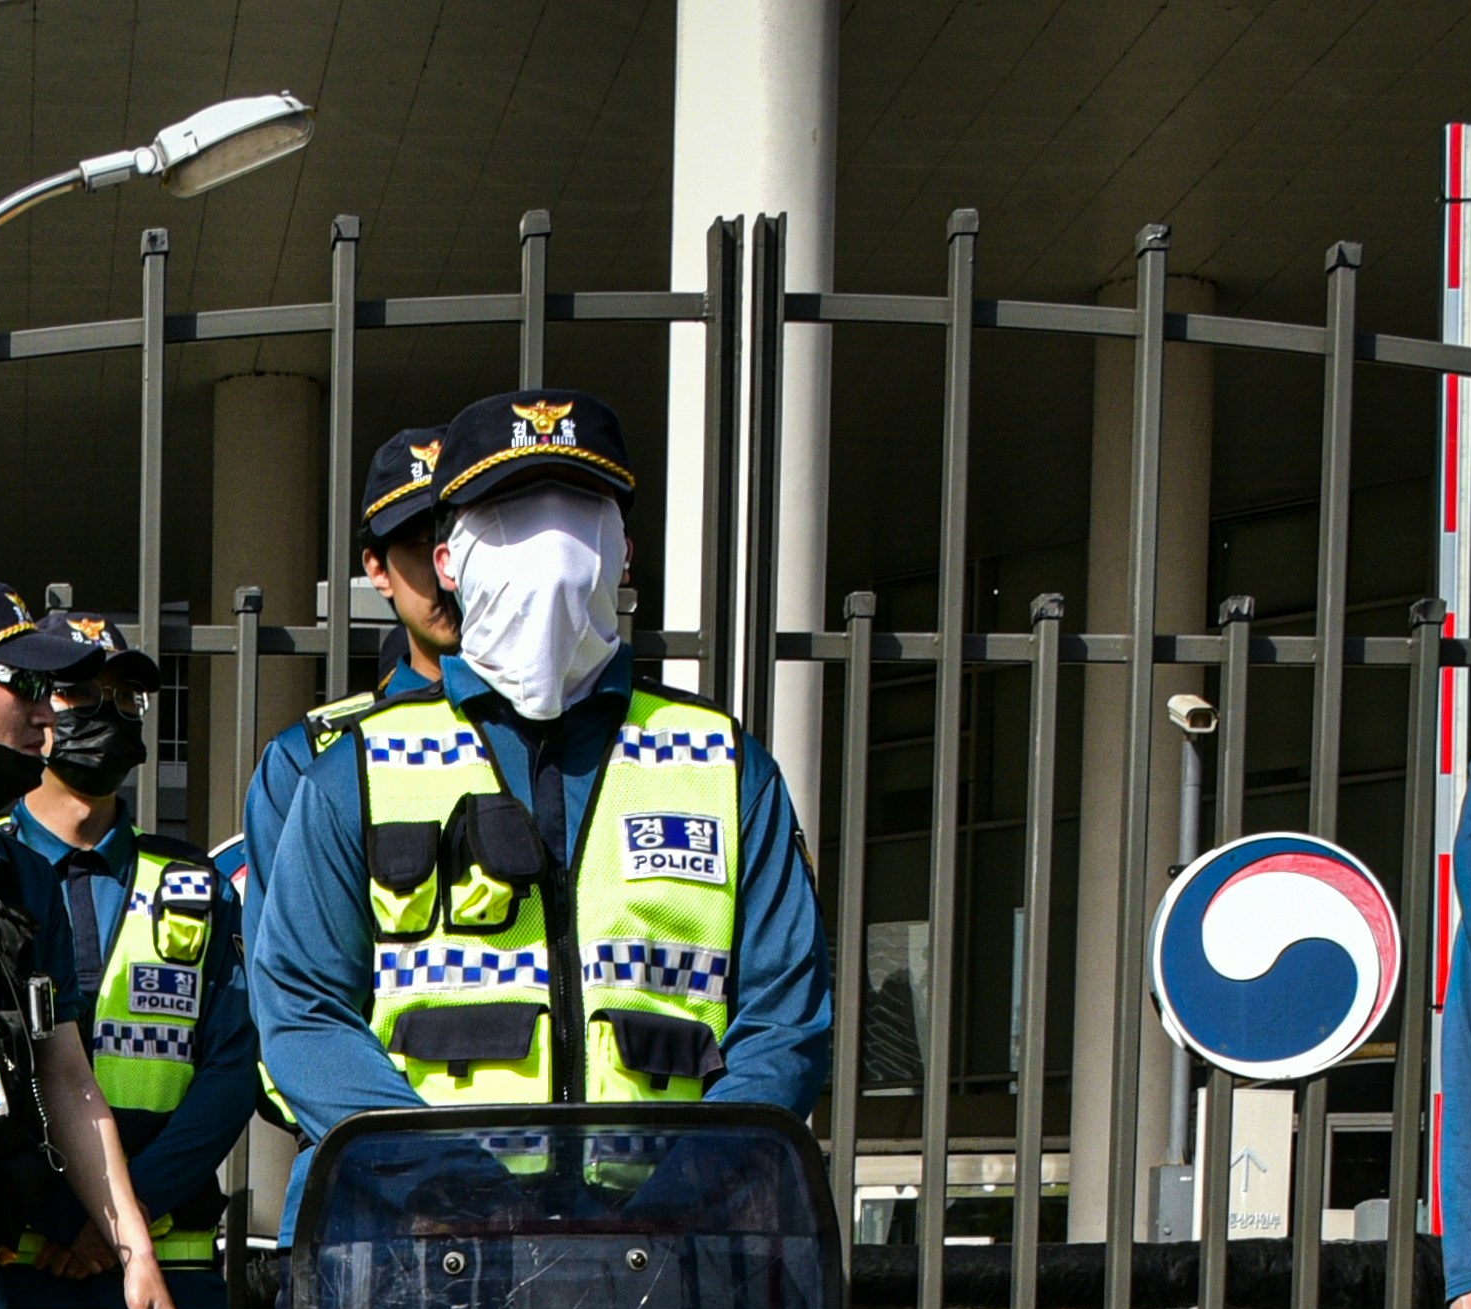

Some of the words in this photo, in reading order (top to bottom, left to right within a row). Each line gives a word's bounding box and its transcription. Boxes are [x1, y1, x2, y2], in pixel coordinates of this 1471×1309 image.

[632, 818, 713, 850] 경찰
[634, 854, 715, 873] POLICE
[138, 967, 194, 995] 경찰
[137, 995, 193, 1013] POLICE
